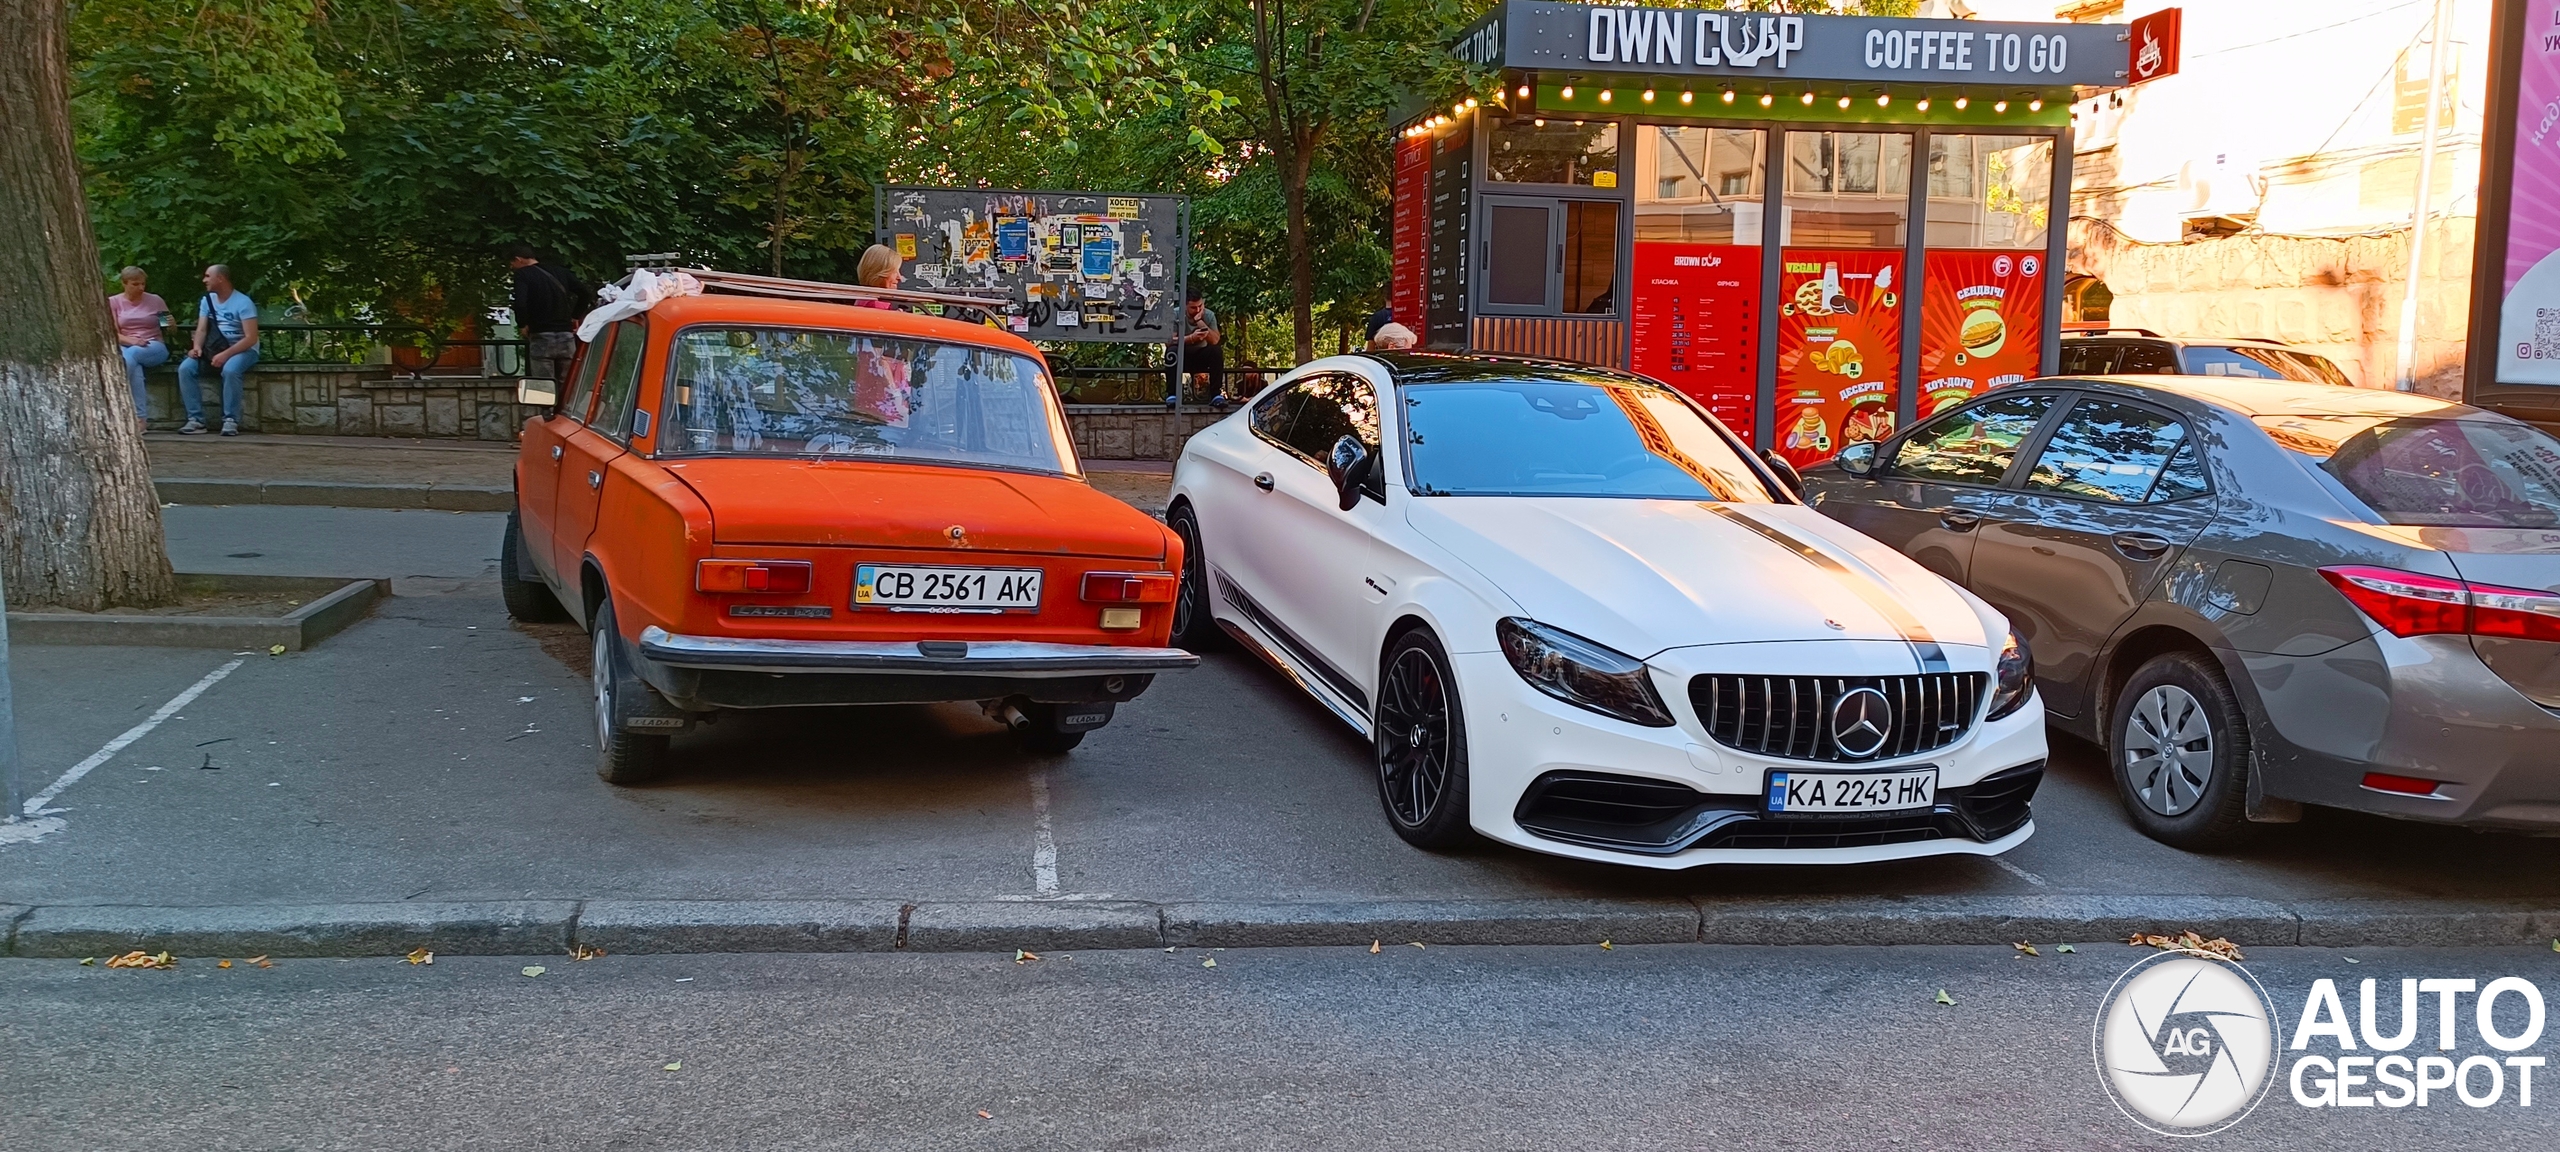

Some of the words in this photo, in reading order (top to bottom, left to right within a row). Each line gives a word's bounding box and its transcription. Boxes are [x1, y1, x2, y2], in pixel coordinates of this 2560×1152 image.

[1485, 19, 1499, 63] GO
[1588, 8, 1683, 65] OWN
[1864, 28, 1974, 72] COFFEE
[1985, 33, 2022, 73] TO
[2028, 34, 2068, 74] GO
[1109, 198, 1138, 207] ХОСТЕЛ
[1674, 256, 1701, 266] BROWN
[1701, 254, 1722, 267] CUP
[1785, 262, 1822, 274] VEGAN
[1956, 285, 2006, 300] СЕНДВІЧІ
[1839, 381, 1885, 402] ДЕСЕРТИ
[1924, 376, 1975, 393] ХОТ-ДОГИ
[857, 590, 870, 598] UA
[876, 572, 914, 598] CB
[922, 574, 986, 601] 2561
[997, 575, 1035, 602] AK
[1771, 796, 1783, 805] UA
[1787, 779, 1827, 806] KA
[1834, 779, 1893, 807] 2243
[1897, 775, 1931, 804] HK
